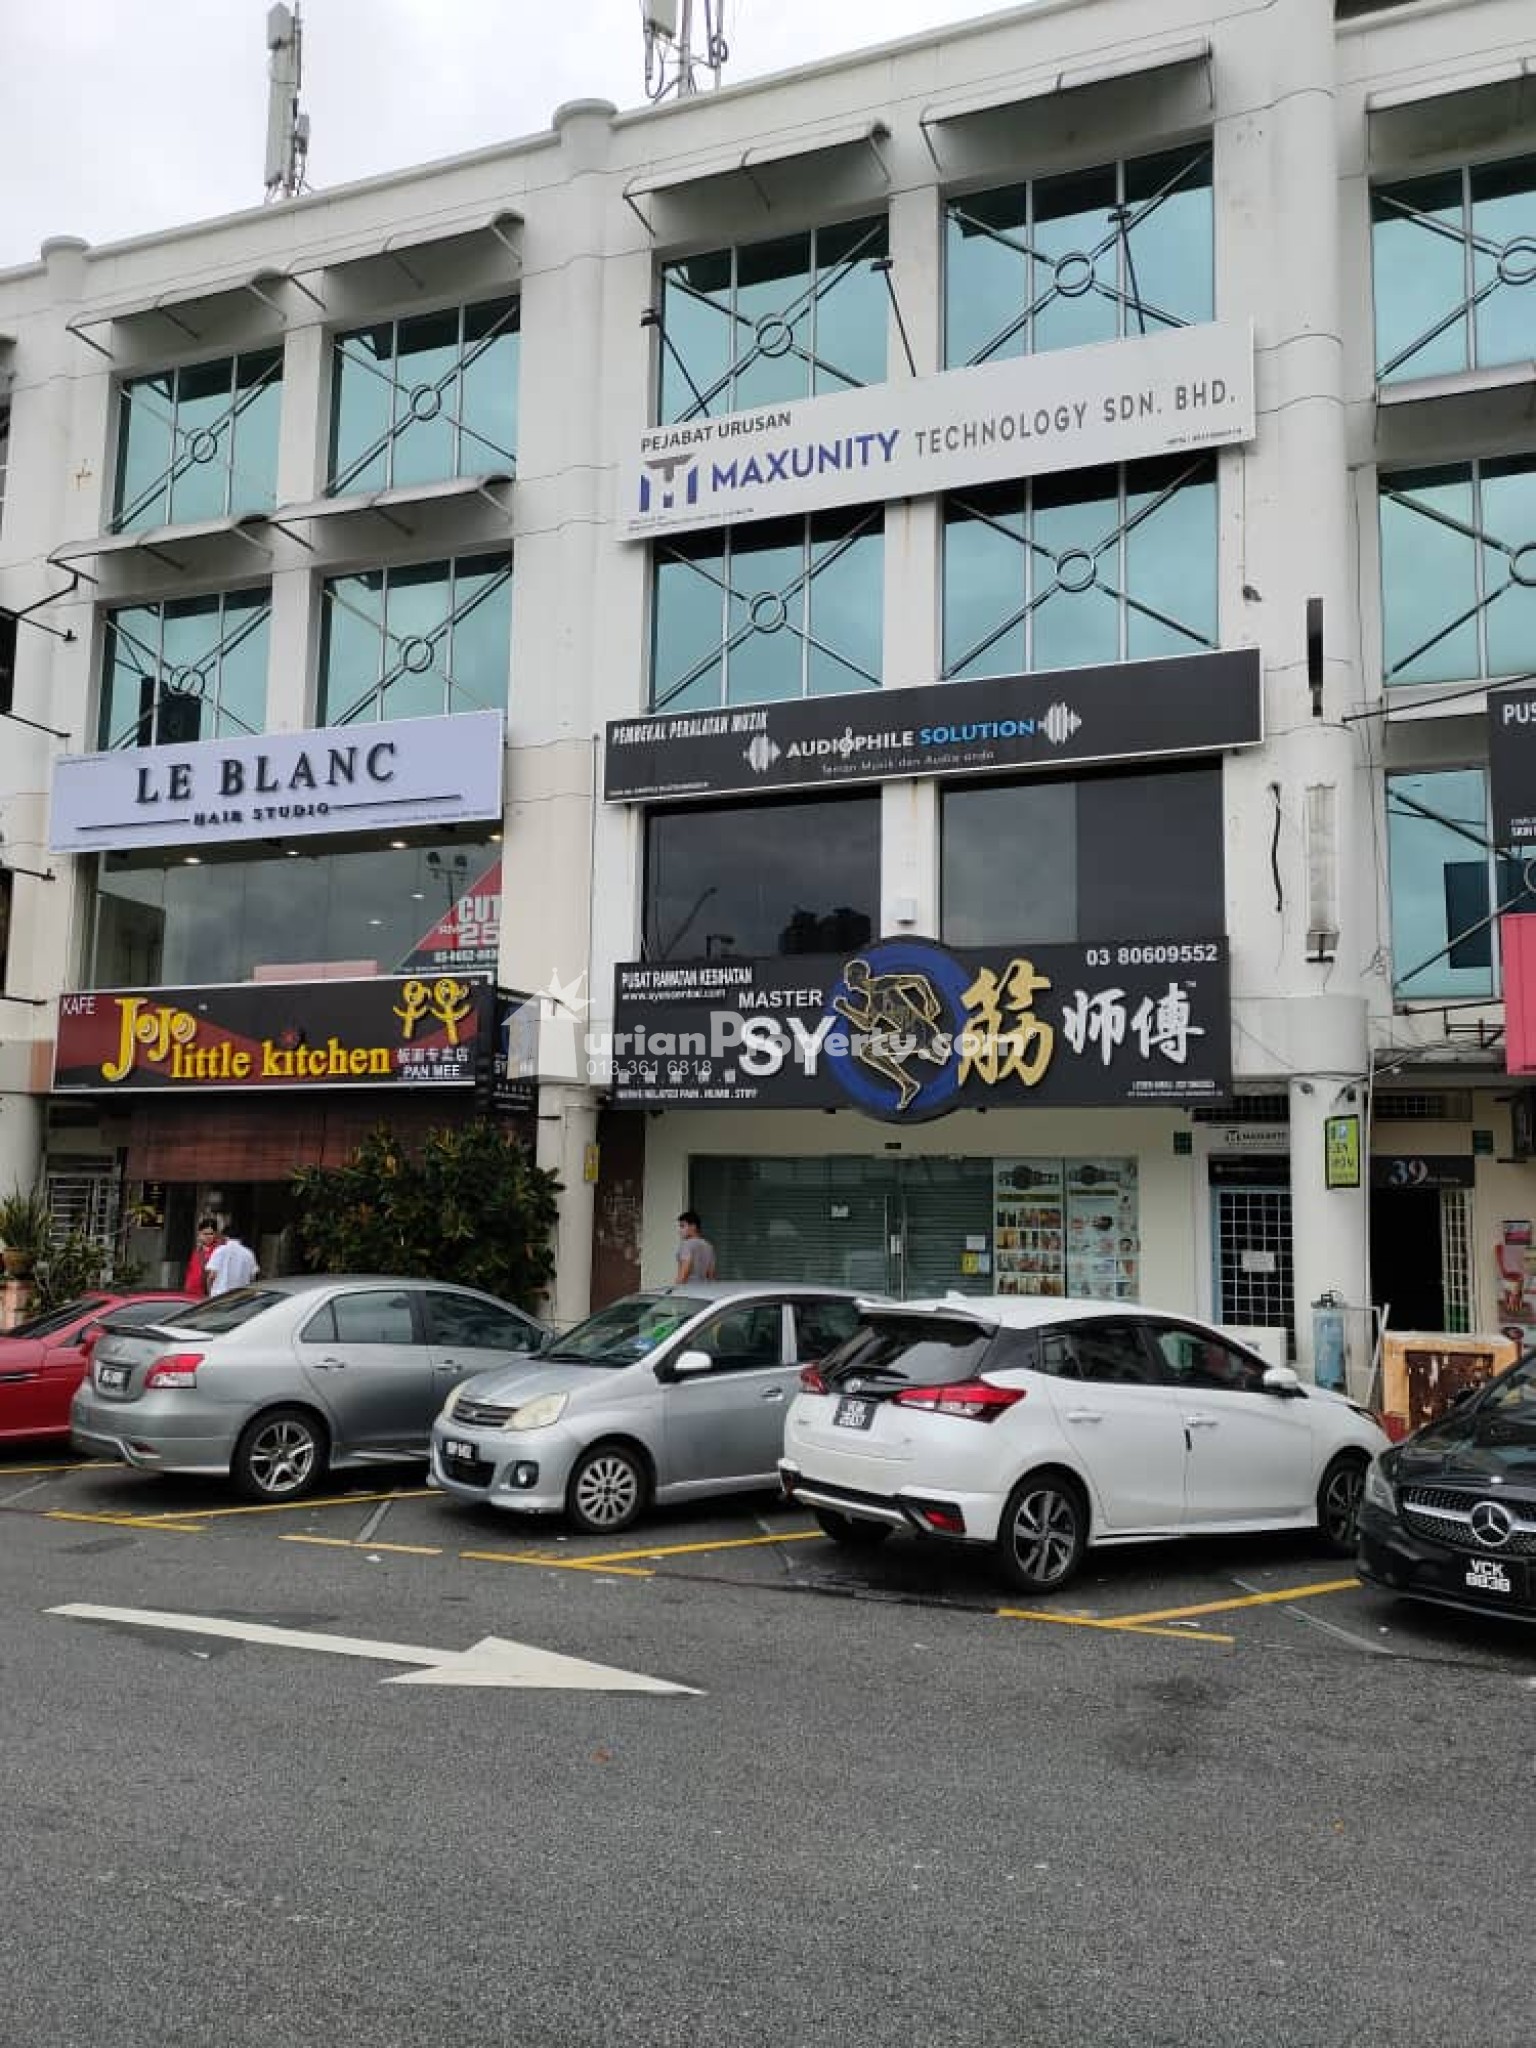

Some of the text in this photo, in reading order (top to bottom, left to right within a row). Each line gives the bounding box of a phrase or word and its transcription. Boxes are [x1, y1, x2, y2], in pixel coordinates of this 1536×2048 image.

[640, 411, 793, 453] PEJABAT URUSAN
[711, 379, 1237, 493] MAXUNITY TECHNOLOGY SDN. BHD.
[918, 717, 1036, 746] SOLUTION
[135, 742, 396, 804] LE BLANC
[193, 802, 330, 826] HAIR STUDIO
[458, 923, 500, 947] 25
[1086, 943, 1218, 966] 03 80609552
[61, 996, 97, 1017] KAFE
[738, 989, 824, 1009] MASTER
[170, 1036, 392, 1079] little kitchen
[738, 1015, 837, 1077] SY
[402, 1063, 429, 1079] PAN
[1388, 1159, 1429, 1186] 39
[1470, 1558, 1504, 1578] VCK
